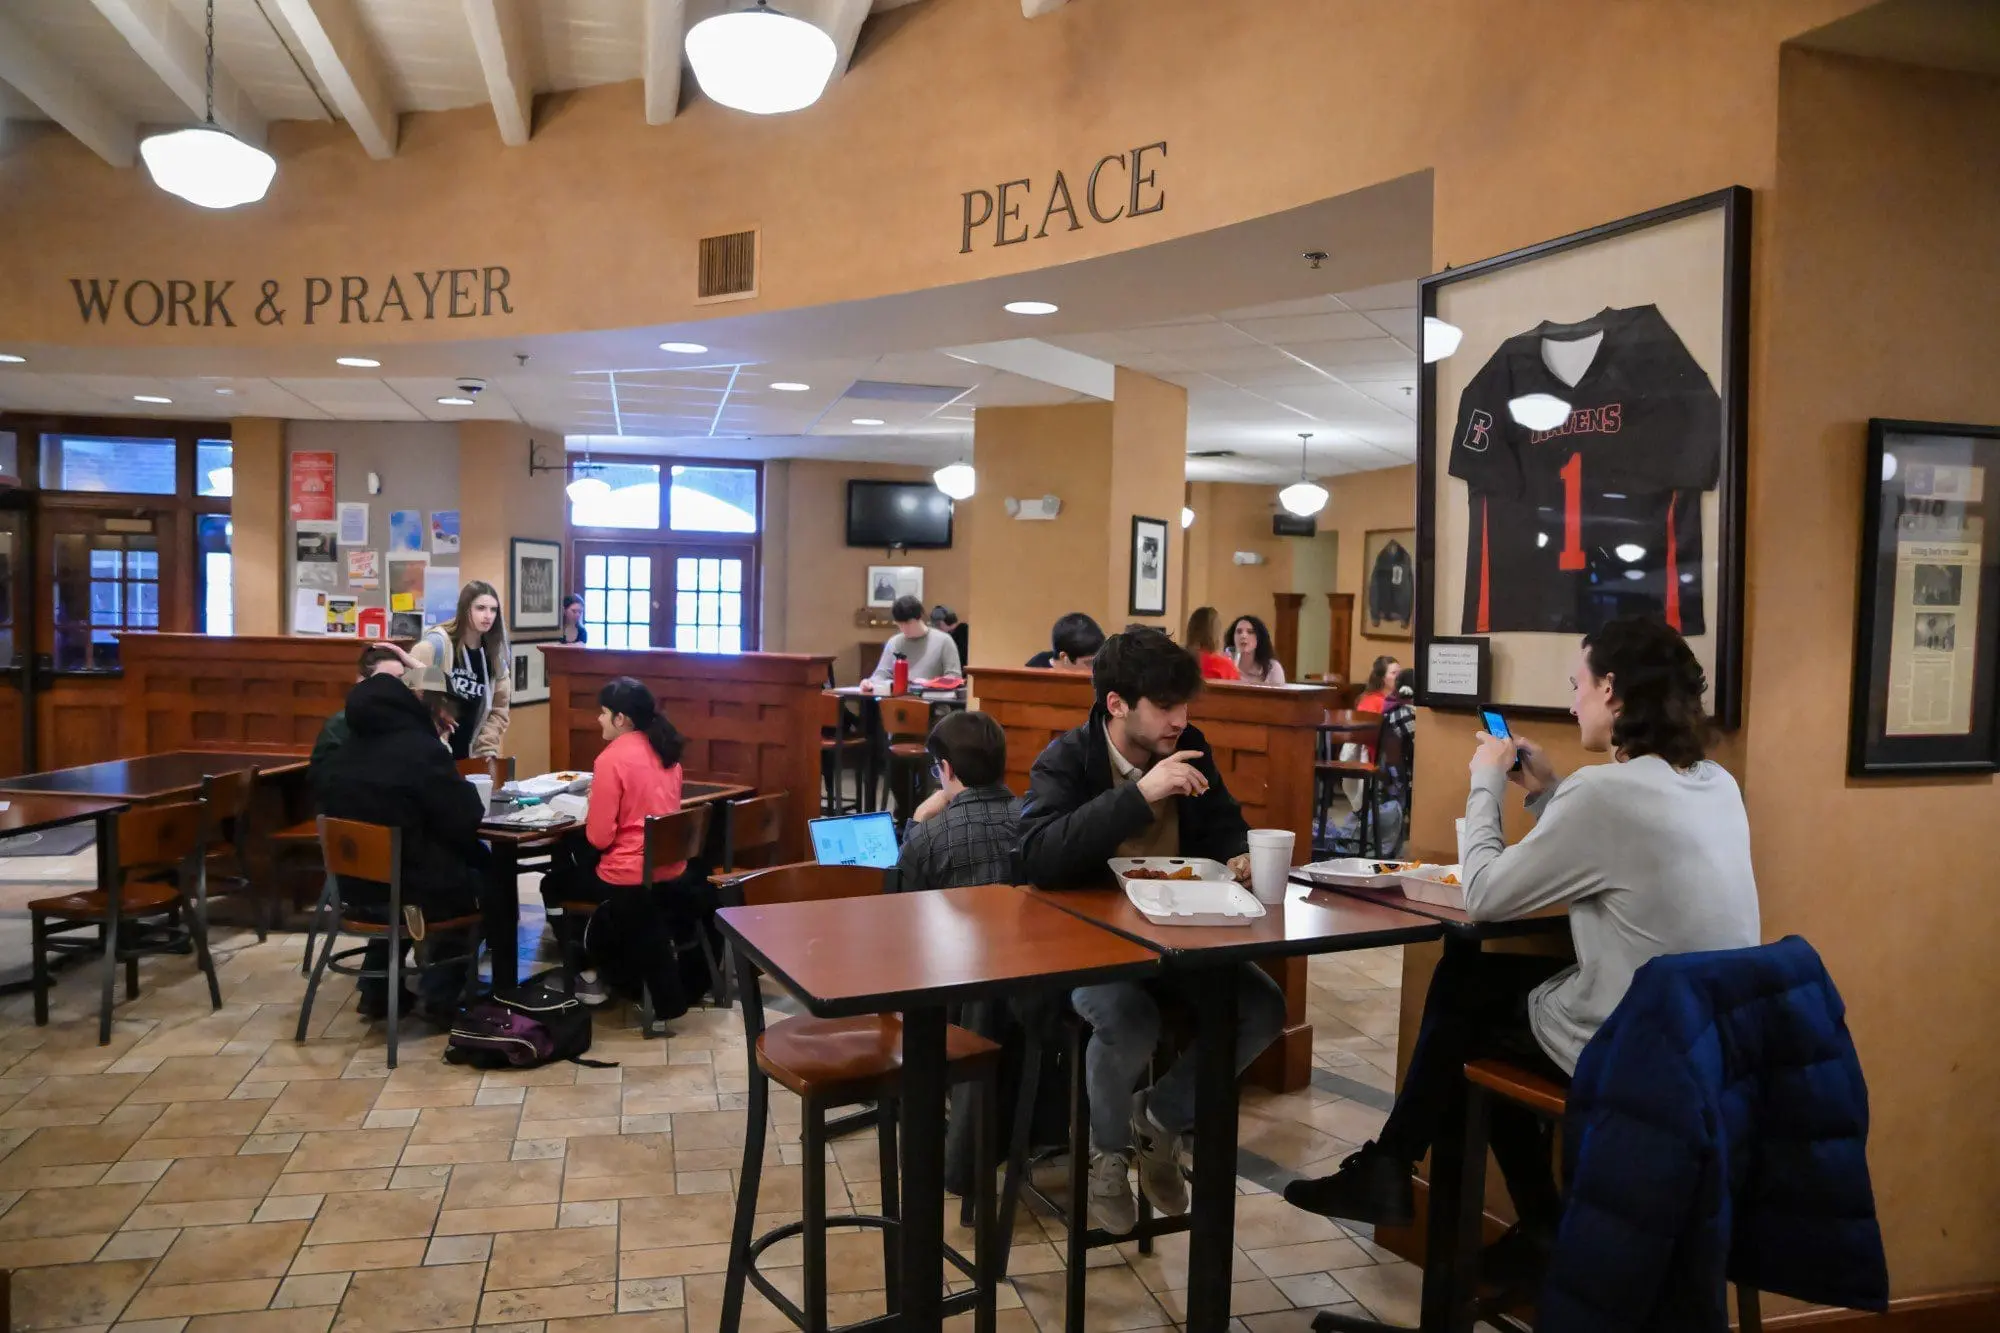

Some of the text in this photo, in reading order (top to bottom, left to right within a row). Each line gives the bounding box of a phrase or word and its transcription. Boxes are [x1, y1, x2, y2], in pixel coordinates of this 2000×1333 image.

[958, 140, 1167, 254] PEACE
[69, 265, 514, 328] WORK & PRAYER
[1559, 451, 1587, 572] 1
